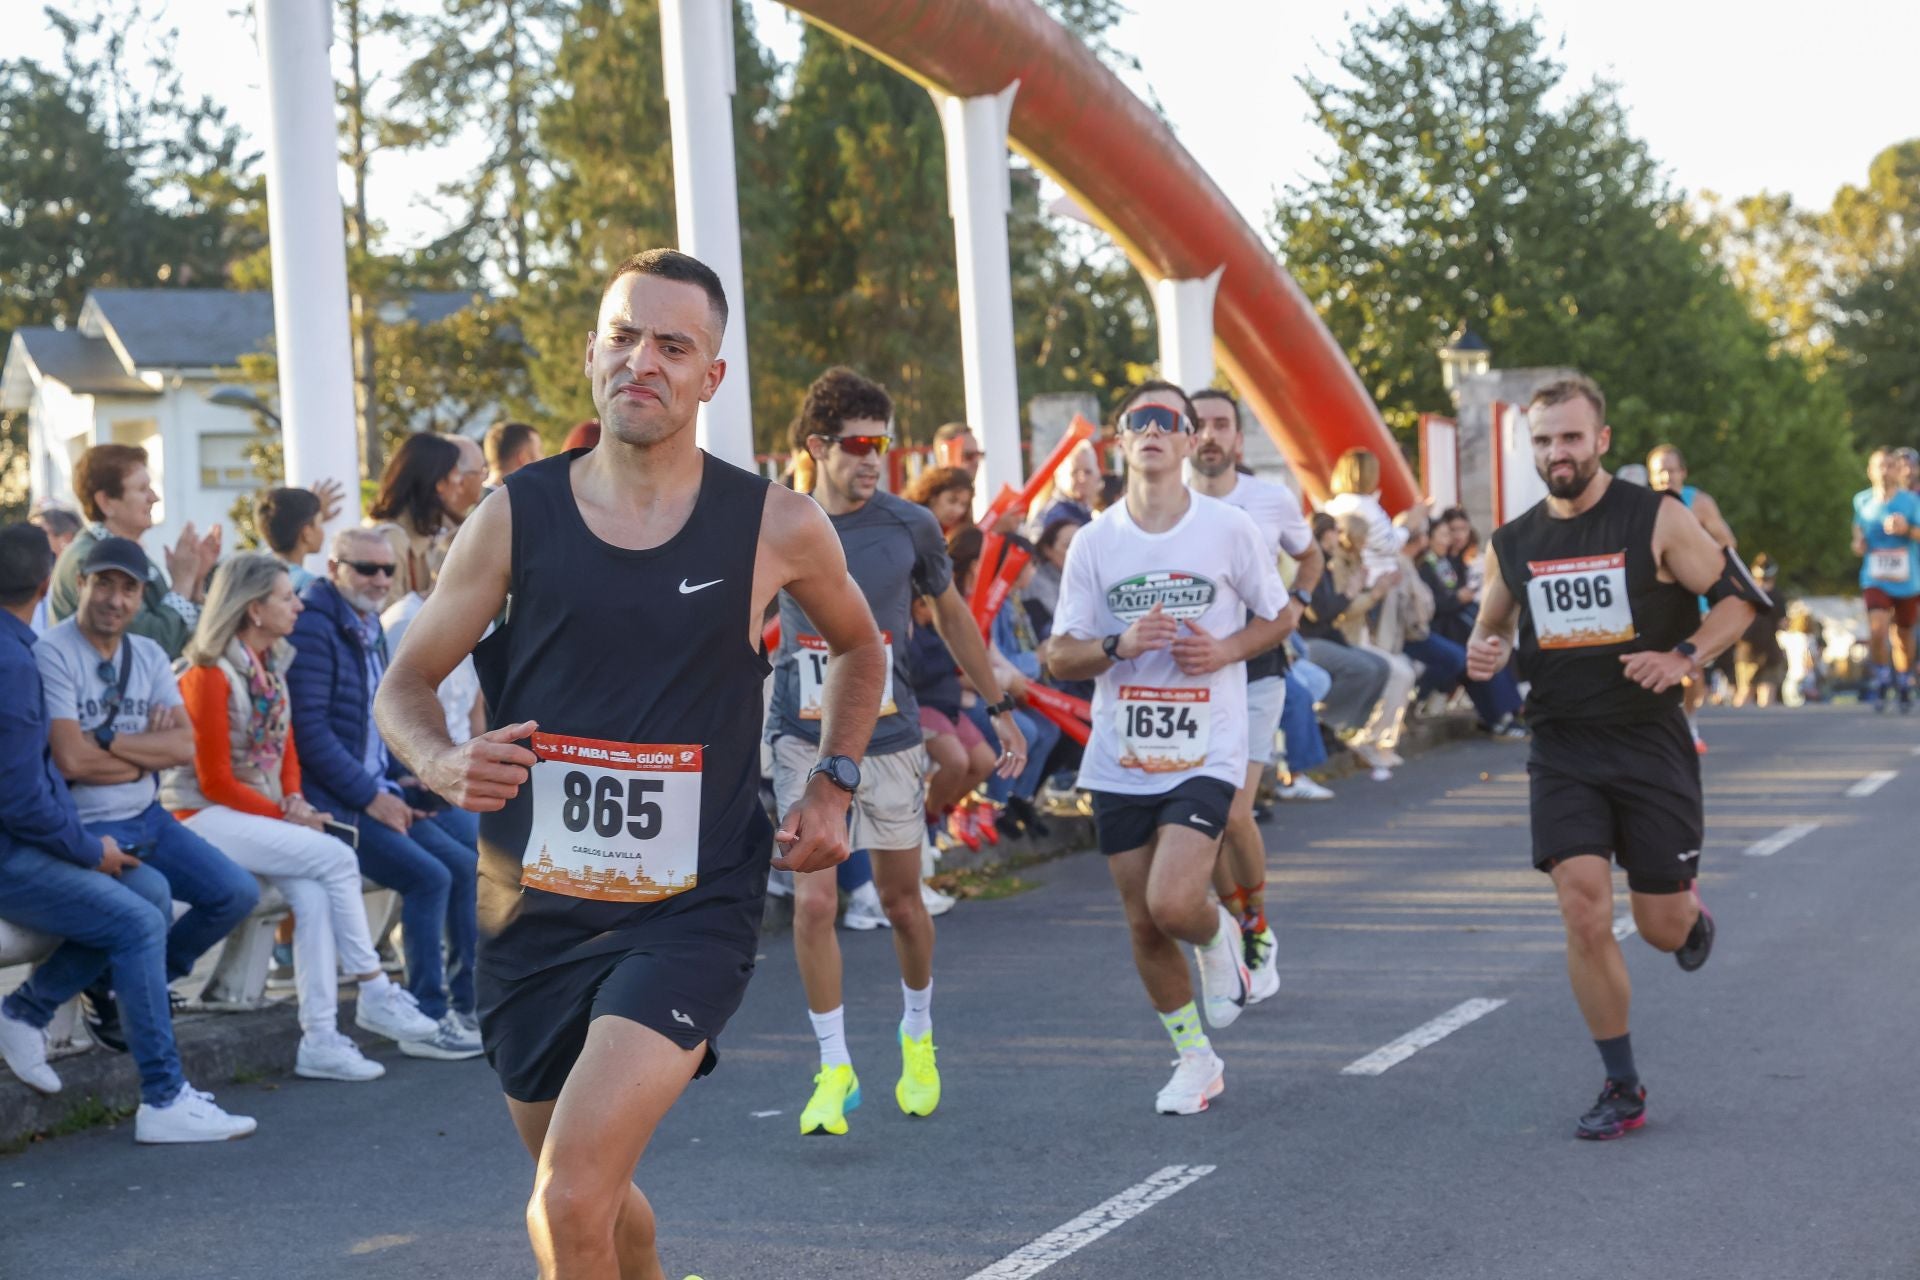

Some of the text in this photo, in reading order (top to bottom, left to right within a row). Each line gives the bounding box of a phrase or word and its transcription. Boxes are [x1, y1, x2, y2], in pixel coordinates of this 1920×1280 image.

[1541, 574, 1613, 613] 1896
[1126, 704, 1198, 739] 1634
[577, 746, 609, 760] MBA
[637, 751, 674, 764] GIJÓN
[563, 770, 664, 840] 865
[572, 845, 601, 857] CARLOS
